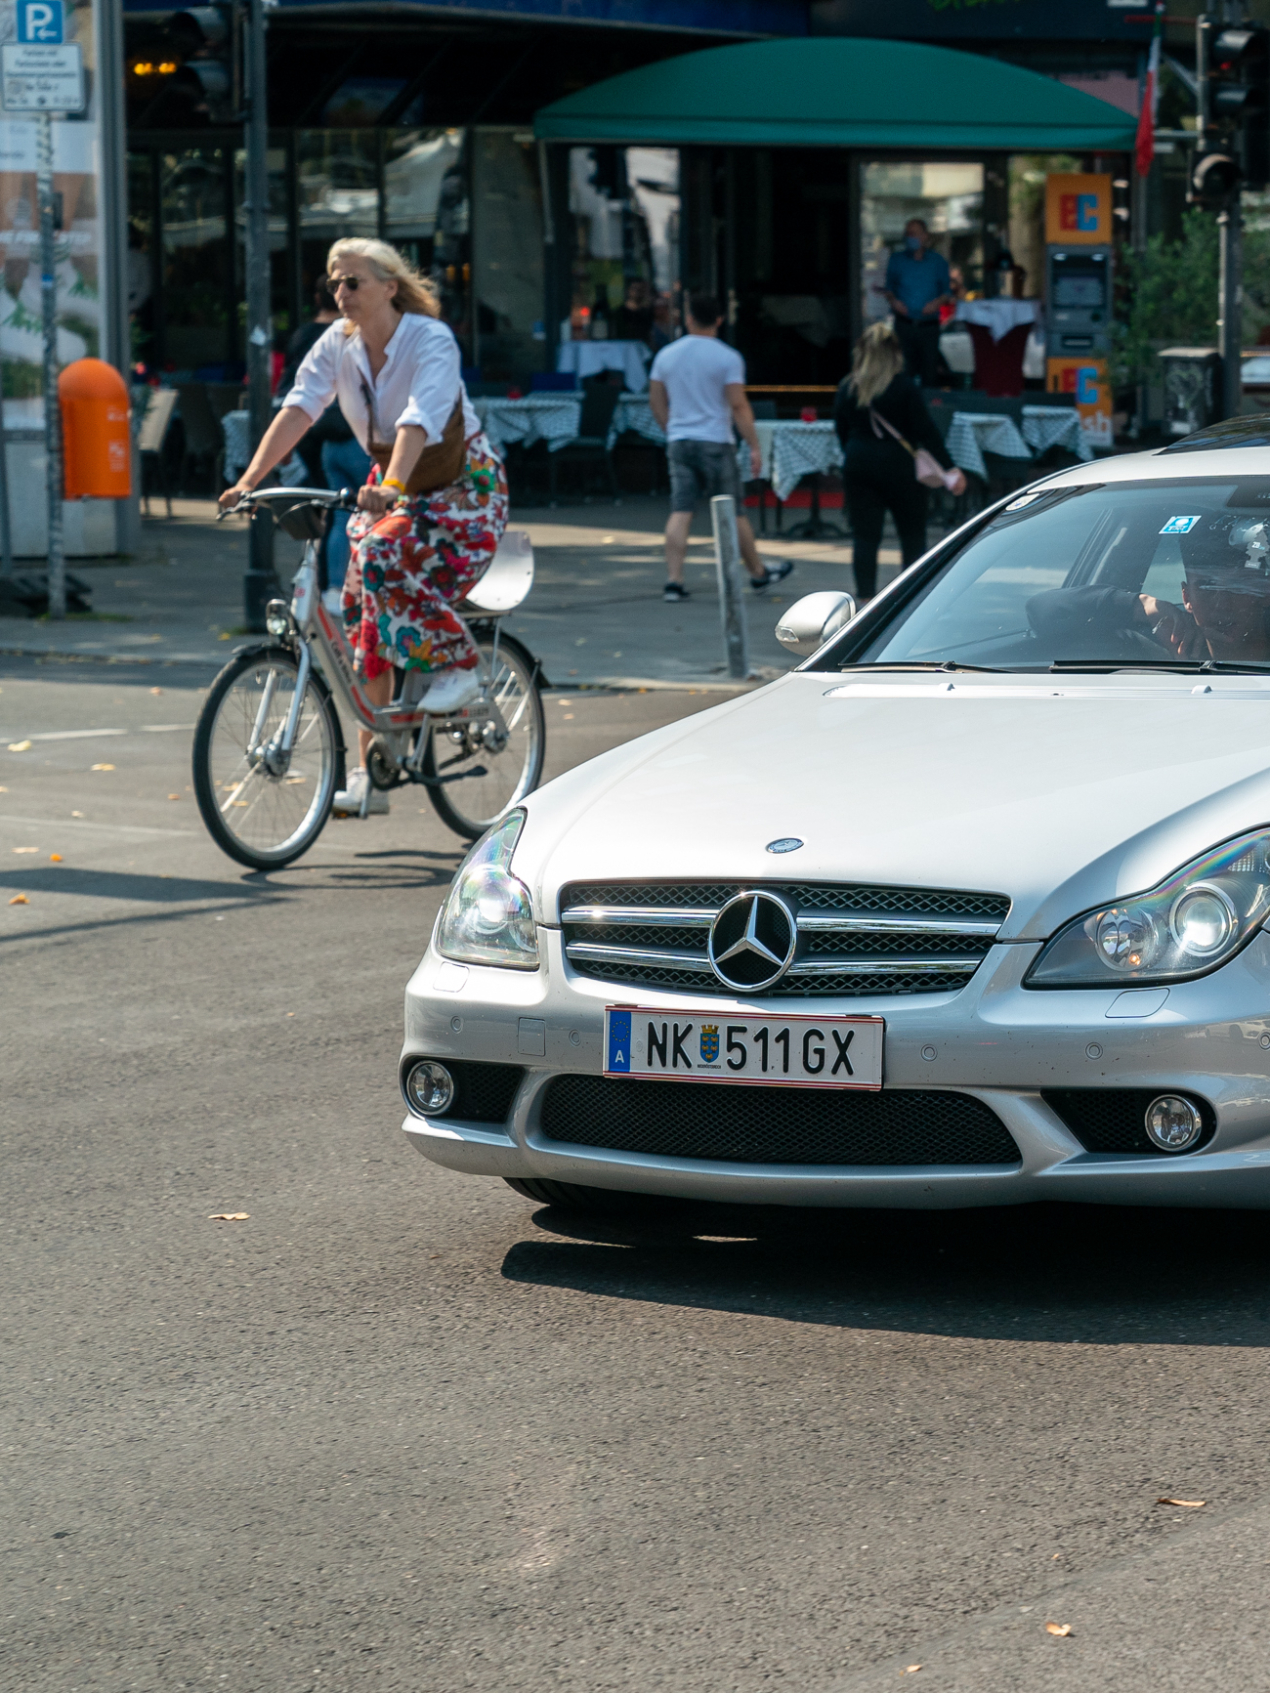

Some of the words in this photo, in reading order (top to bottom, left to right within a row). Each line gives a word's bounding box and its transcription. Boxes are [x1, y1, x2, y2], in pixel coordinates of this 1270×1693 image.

[26, 3, 53, 40] P
[1060, 194, 1098, 231] EC
[615, 1050, 625, 1064] A
[647, 1021, 694, 1069] NK
